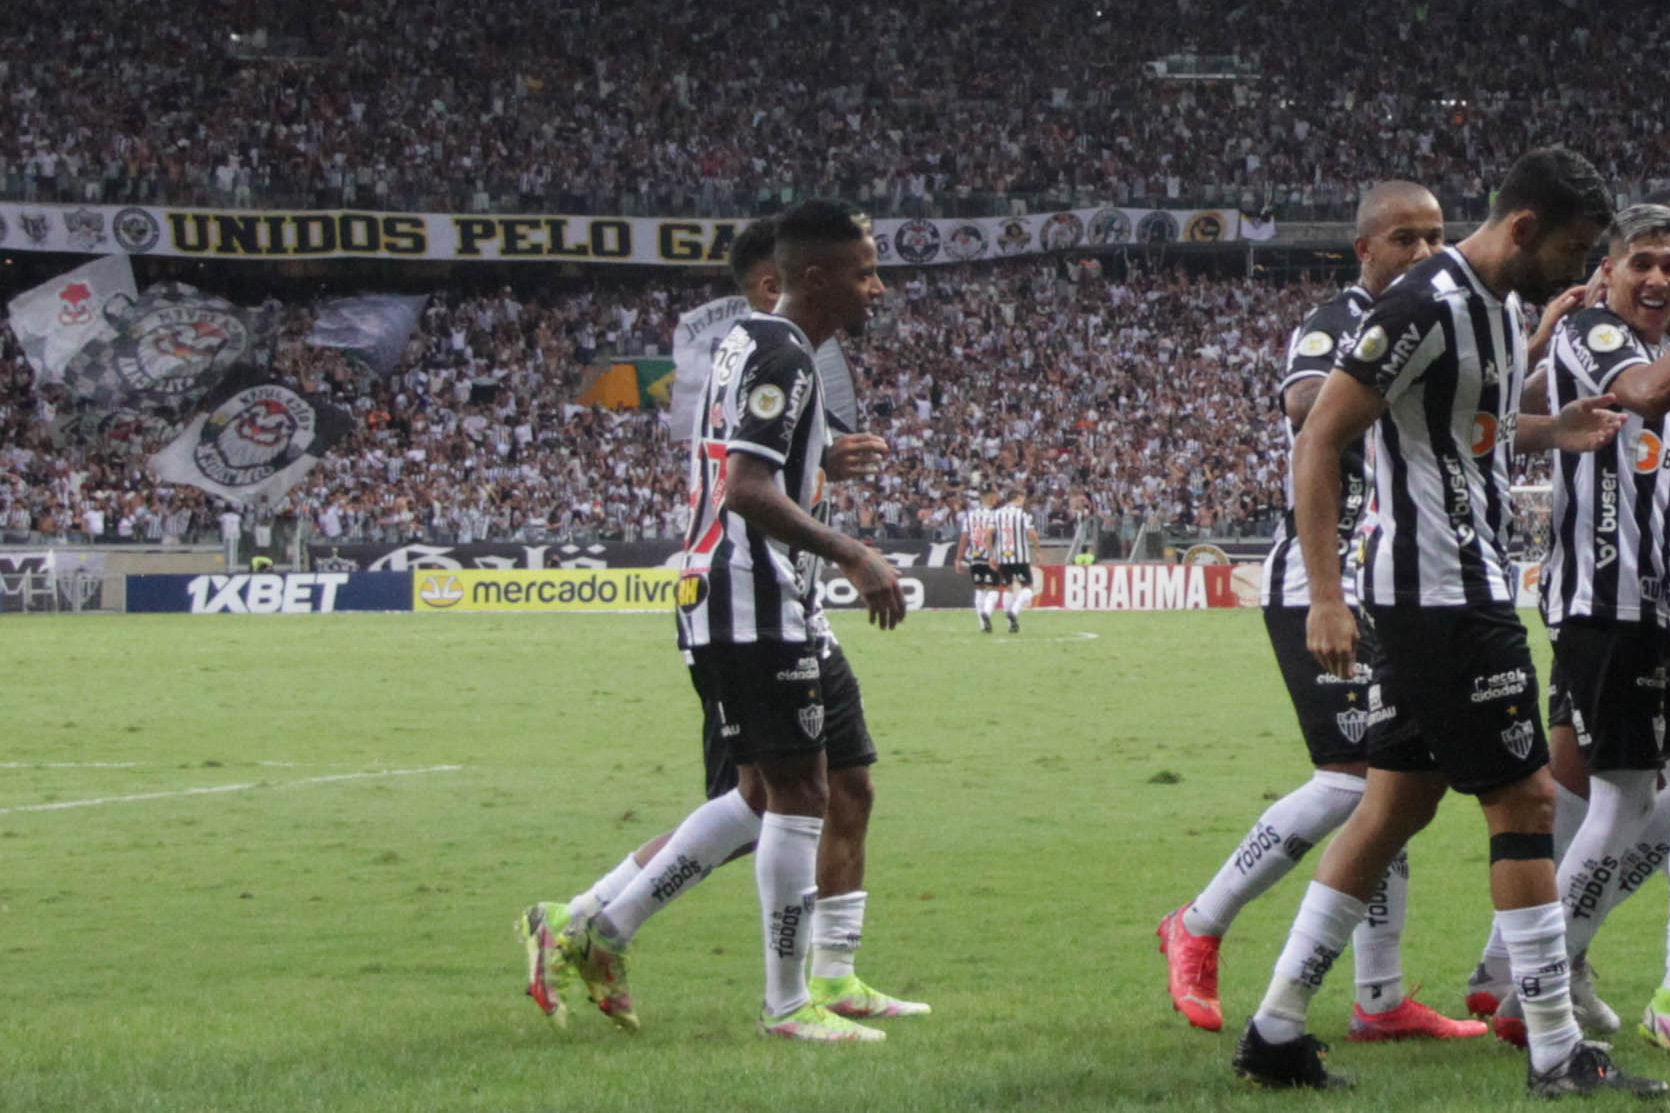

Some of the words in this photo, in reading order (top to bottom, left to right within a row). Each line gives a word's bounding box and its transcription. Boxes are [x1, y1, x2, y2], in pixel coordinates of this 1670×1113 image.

[167, 211, 428, 256] UNIDOS
[453, 217, 632, 260] PELO
[1599, 467, 1618, 533] buser
[186, 572, 349, 613] 1XBET
[472, 574, 617, 604] mercado
[625, 573, 680, 603] livr
[1064, 565, 1208, 609] BRAHMA
[1235, 825, 1281, 875] TODOS
[1619, 842, 1670, 892] TODOS
[651, 860, 702, 903] TODOS
[1573, 855, 1618, 919] TODOS
[777, 905, 802, 959] TODOS
